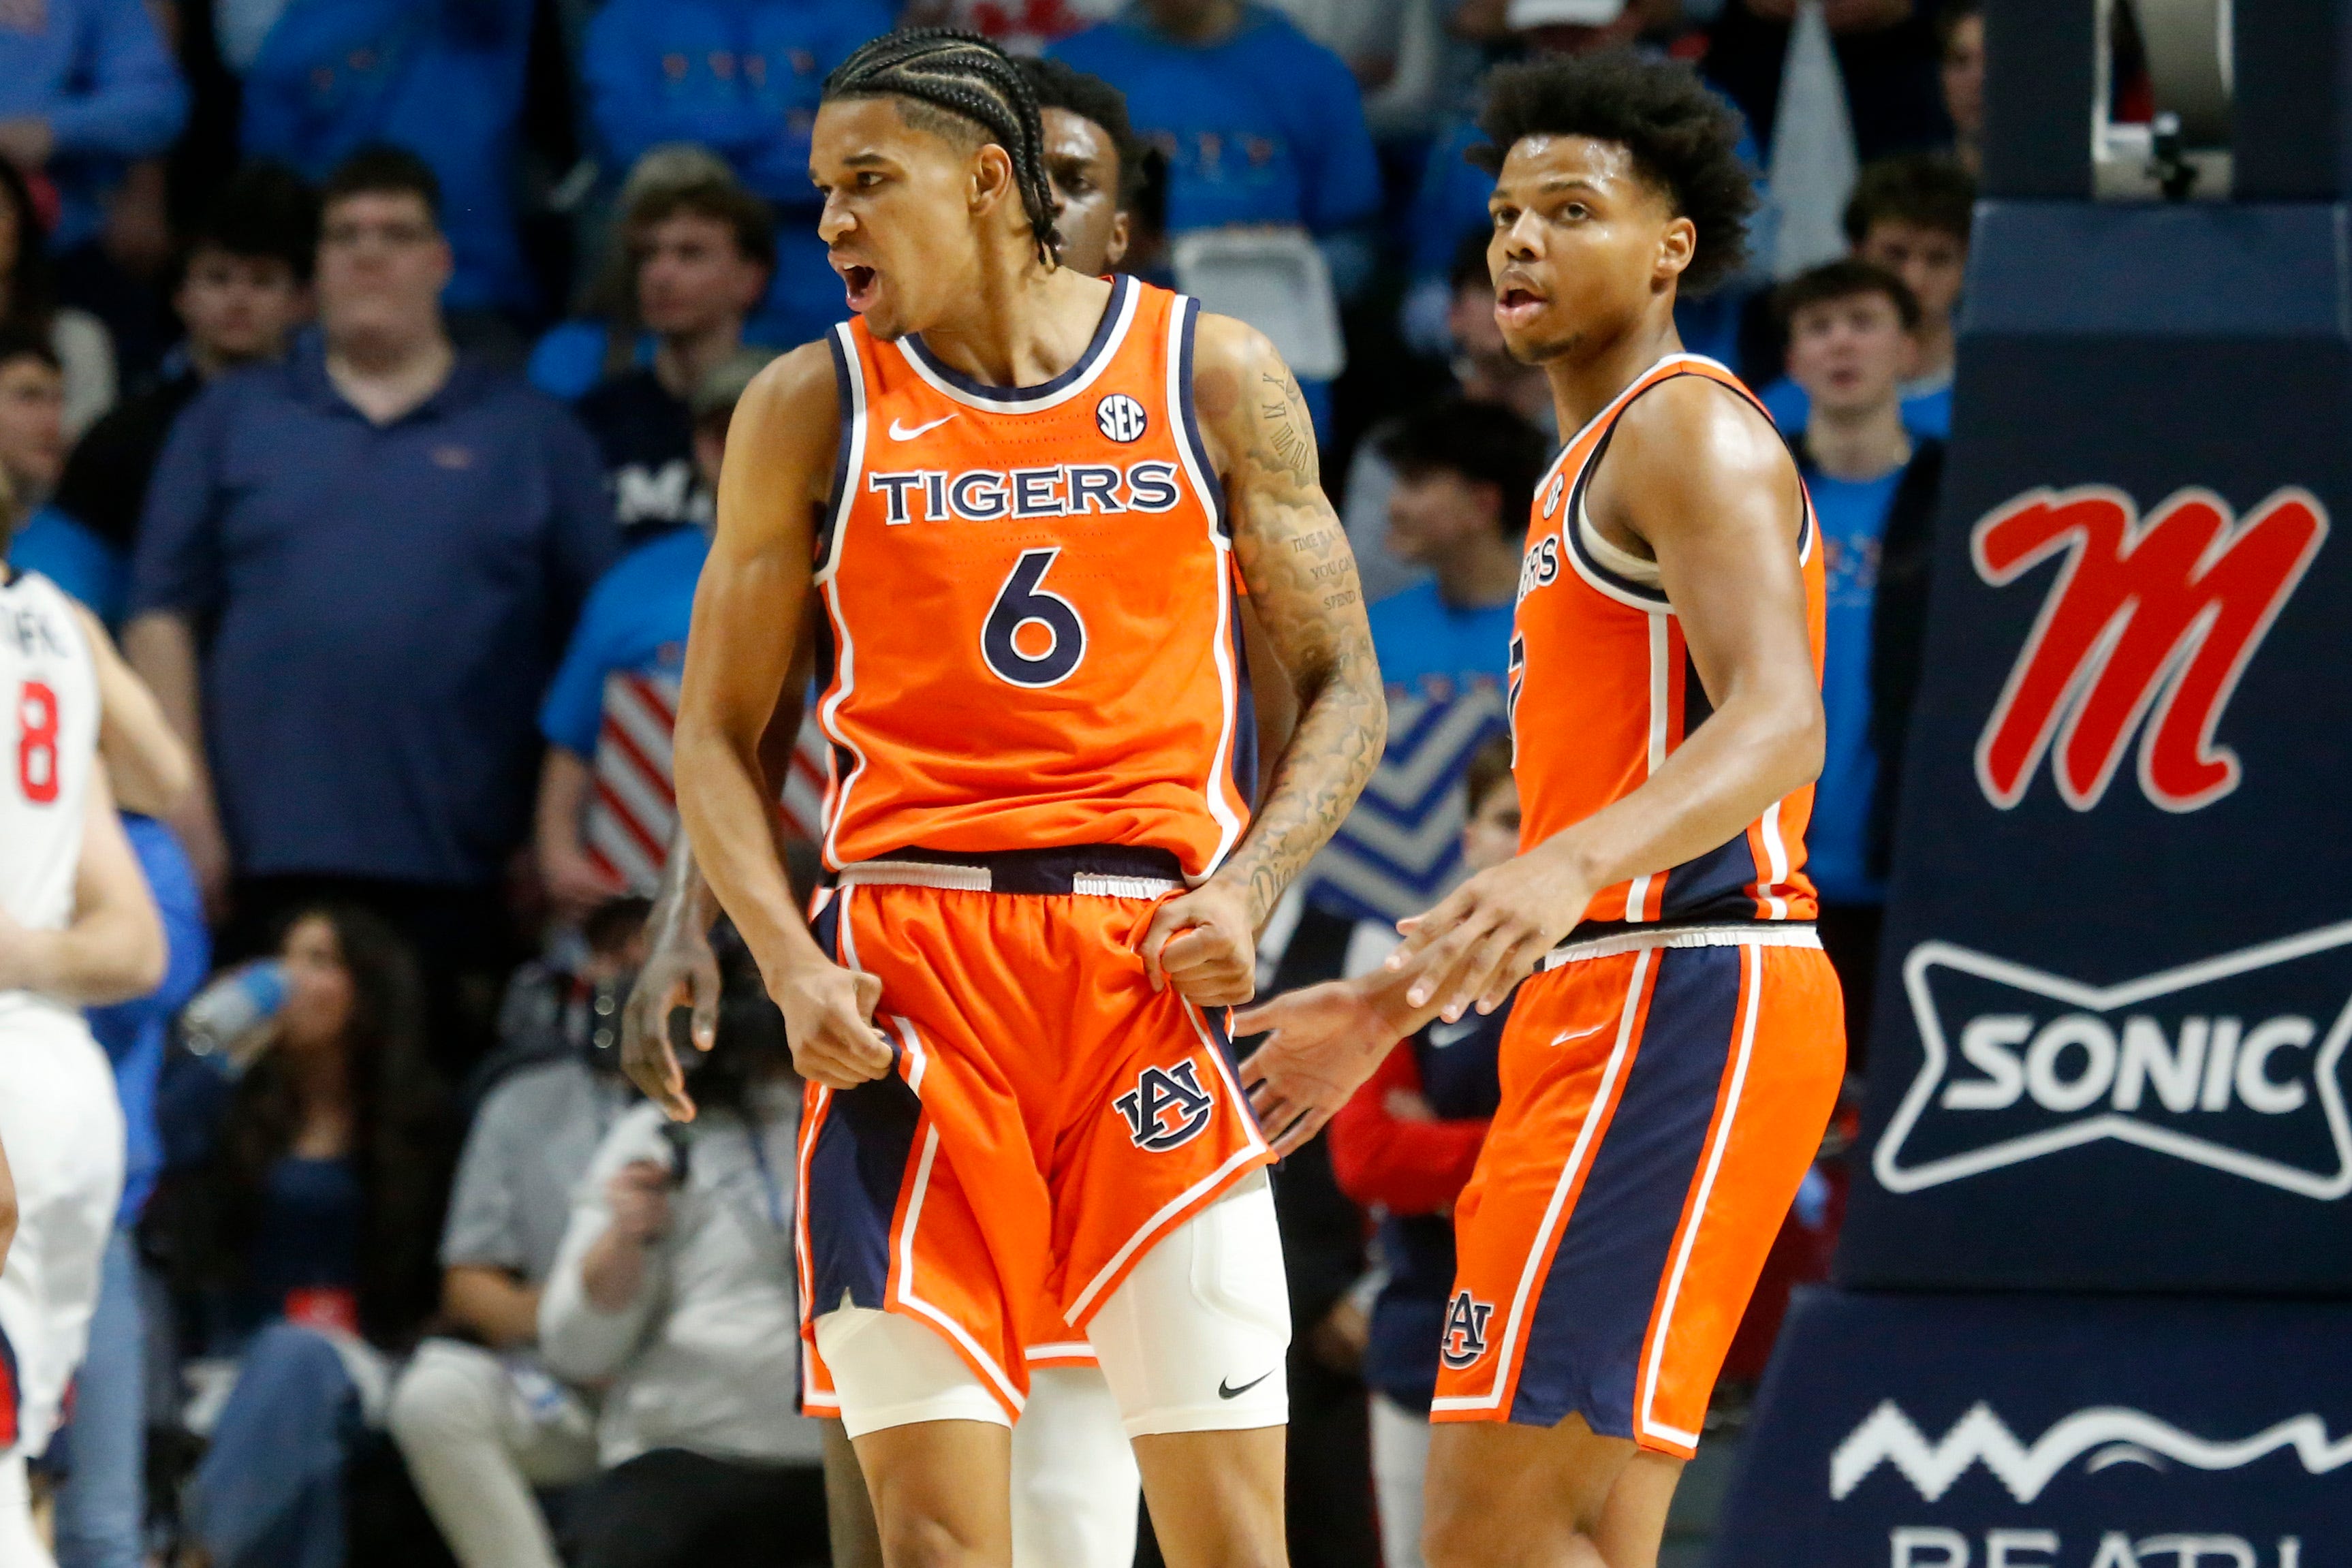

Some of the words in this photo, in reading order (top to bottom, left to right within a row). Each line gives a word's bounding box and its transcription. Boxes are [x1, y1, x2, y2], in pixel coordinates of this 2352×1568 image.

[1097, 394, 1146, 443] SEC
[868, 460, 1182, 526] TIGERS
[1310, 561, 1337, 580] YOU
[1323, 589, 1357, 610] SPEND
[980, 546, 1087, 689] 6
[1969, 483, 2331, 814] M
[19, 680, 59, 804] 8
[1941, 1014, 2317, 1114] SONIC
